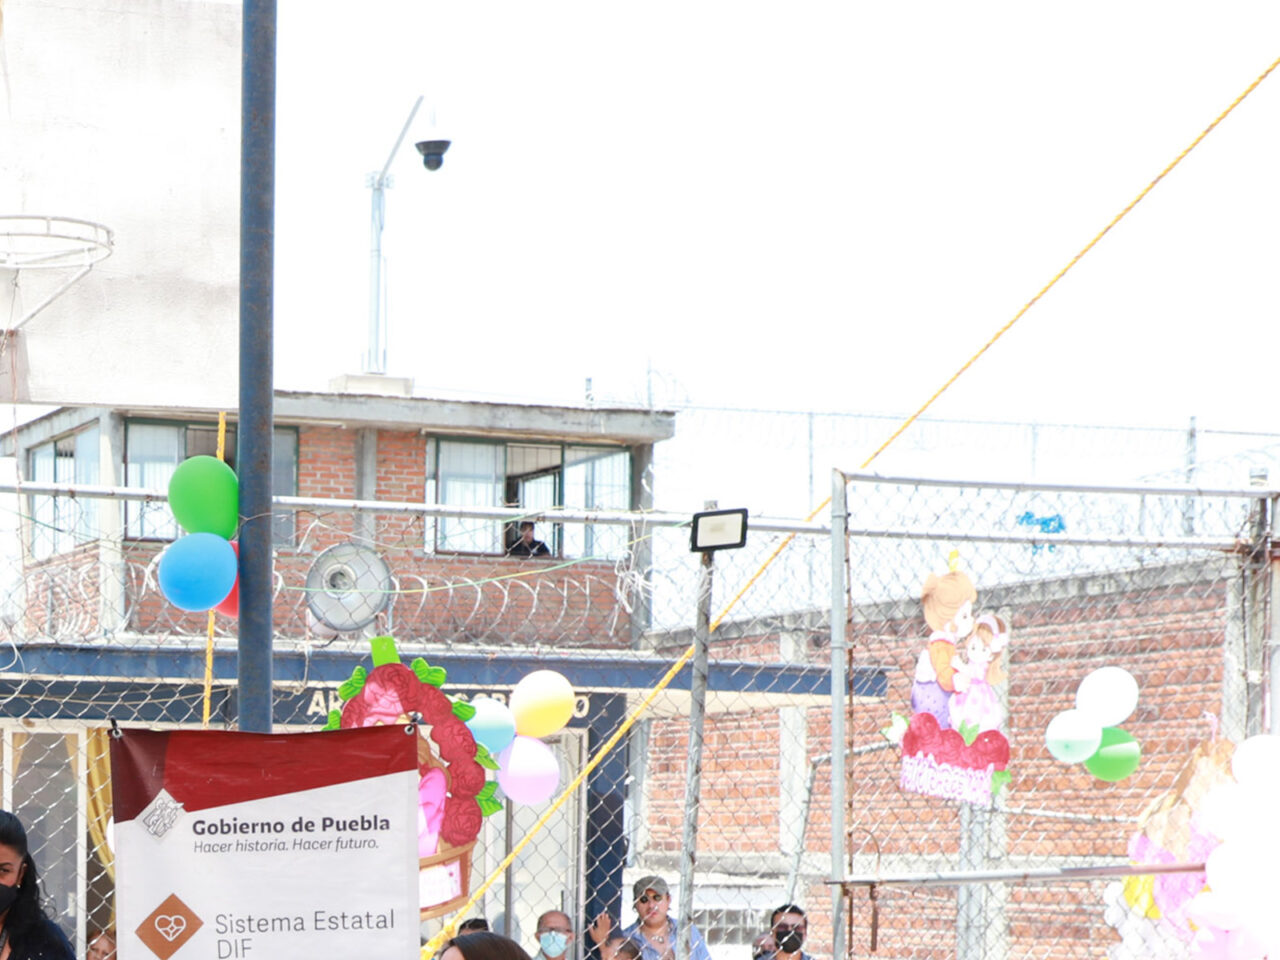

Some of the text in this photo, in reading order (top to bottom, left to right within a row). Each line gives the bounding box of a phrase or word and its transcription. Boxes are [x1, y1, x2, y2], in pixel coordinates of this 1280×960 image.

[192, 815, 390, 835] Gobierno de Puebla
[194, 837, 380, 853] Hacer historia. Hacer futuro.
[215, 909, 395, 935] Sistema Estatal
[217, 938, 253, 960] DIF
